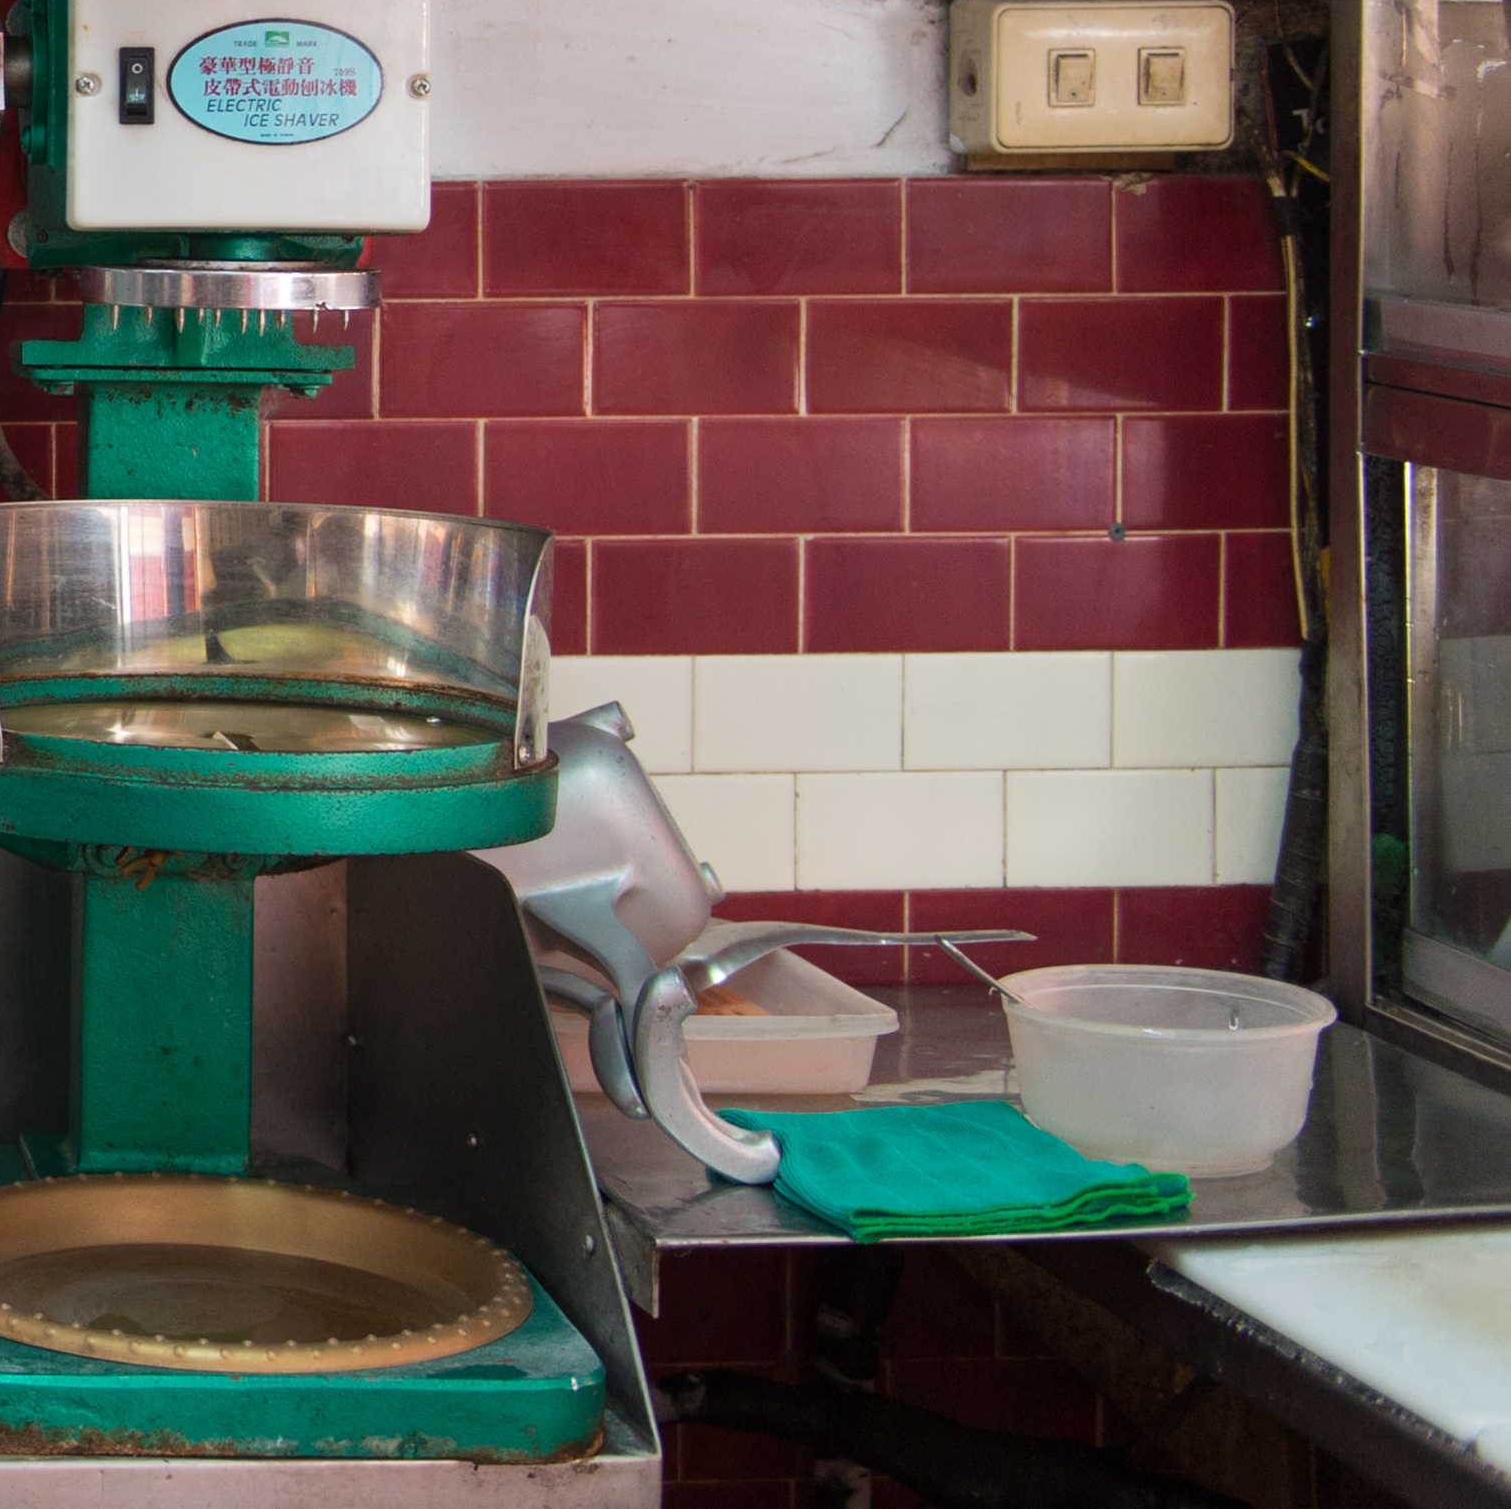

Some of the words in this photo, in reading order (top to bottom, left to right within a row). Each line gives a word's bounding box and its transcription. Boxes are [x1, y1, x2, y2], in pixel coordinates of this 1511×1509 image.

[198, 57, 315, 76] 豪華型極靜音
[203, 79, 357, 97] 皮帶式電動刨冰機
[206, 99, 282, 113] ELECTRIC
[244, 114, 269, 127] ICE
[274, 113, 340, 127] SHAVER
